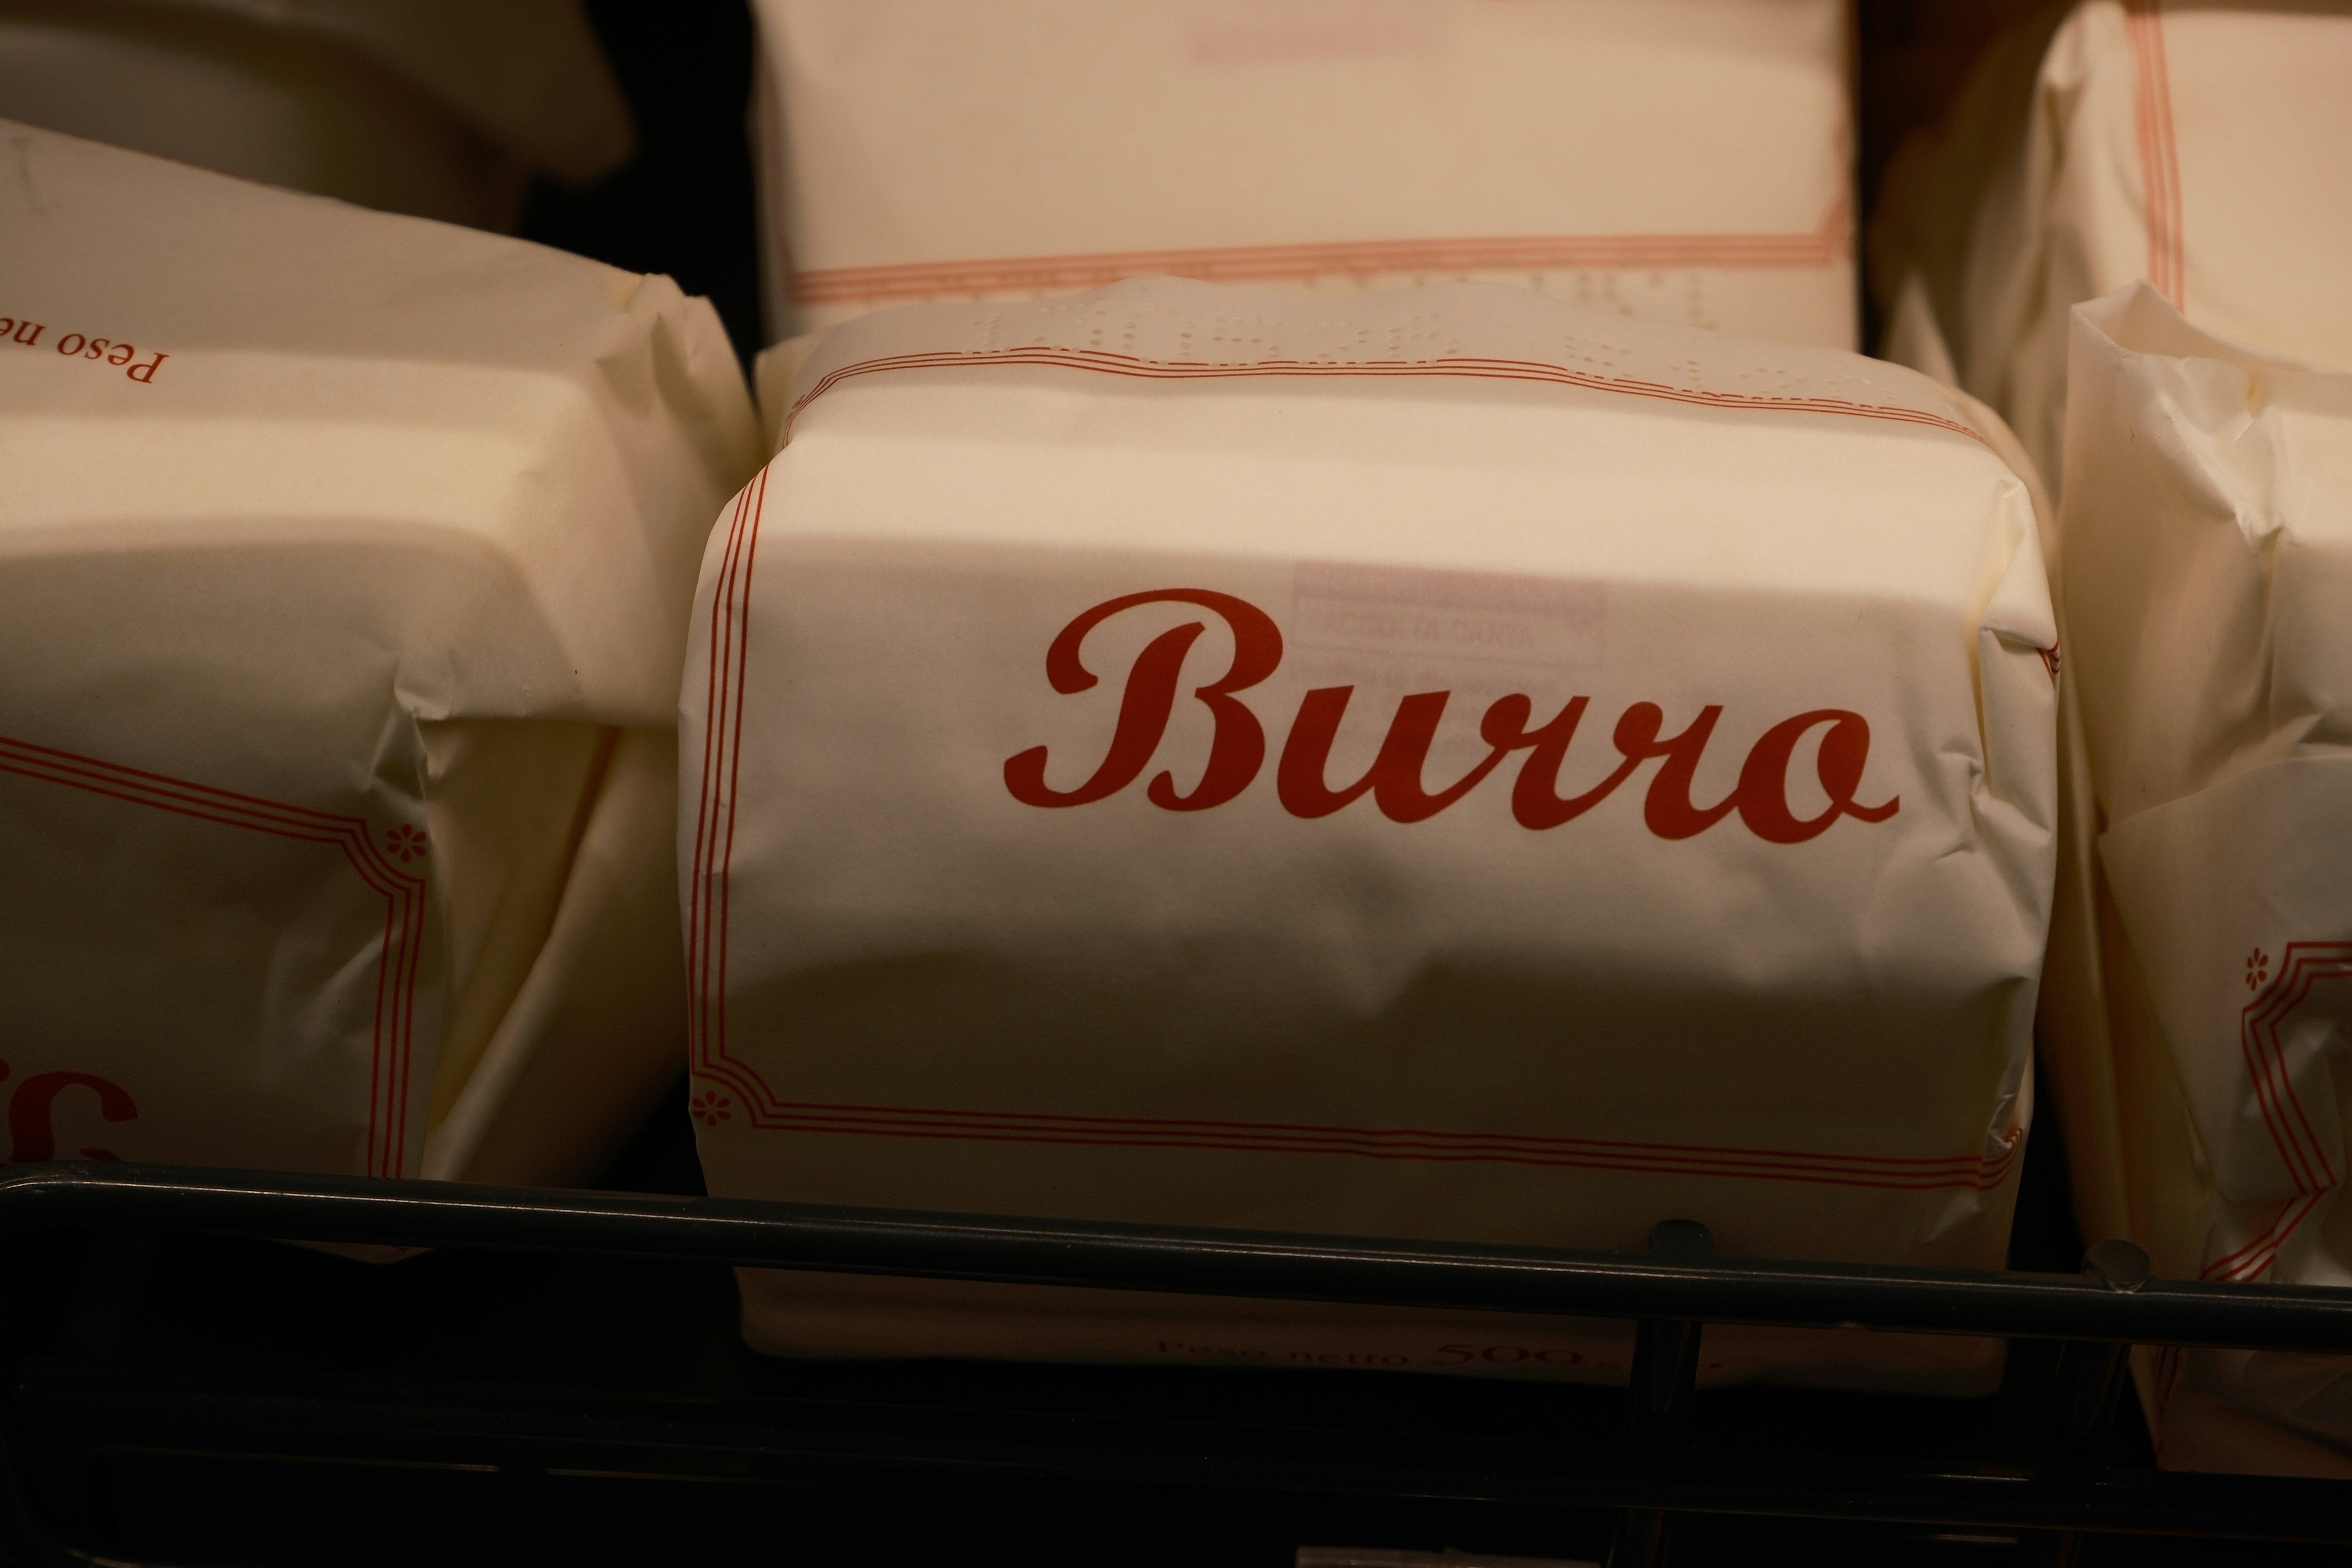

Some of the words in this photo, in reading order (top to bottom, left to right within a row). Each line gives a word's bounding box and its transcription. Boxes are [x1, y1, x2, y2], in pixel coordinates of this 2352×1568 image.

[57, 334, 170, 384] Peso
[1004, 588, 1899, 844] Burro
[1433, 1344, 1583, 1366] 500
